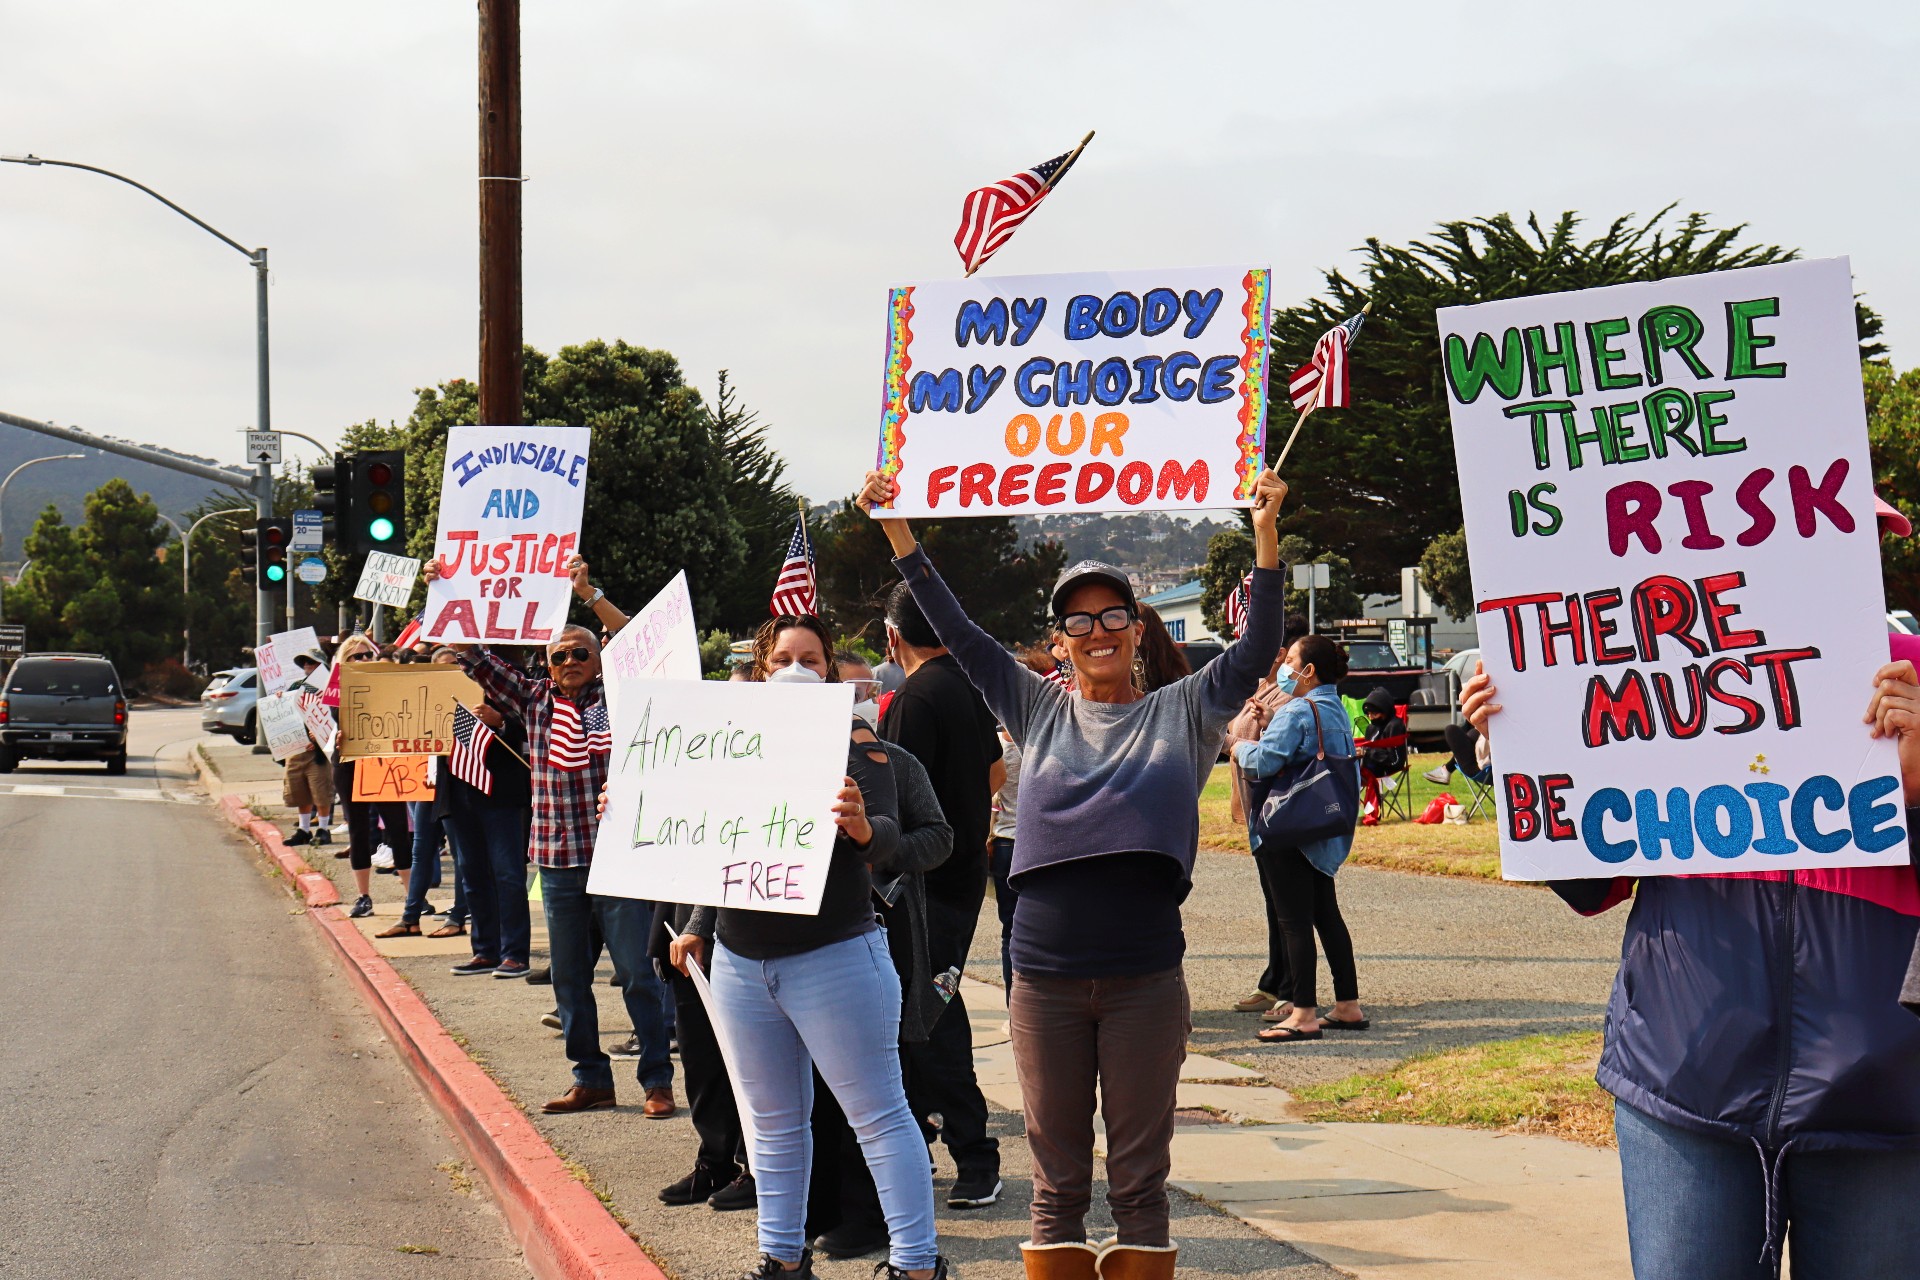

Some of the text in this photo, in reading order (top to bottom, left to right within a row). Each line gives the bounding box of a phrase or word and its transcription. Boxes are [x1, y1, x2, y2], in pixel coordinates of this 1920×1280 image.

[955, 288, 1223, 348] MY BODY
[1444, 297, 1787, 404] WHERE
[909, 351, 1240, 414] MY CHOICE
[250, 434, 278, 442] TRUCK
[1005, 411, 1129, 458] OUR
[1503, 387, 1747, 470] THERE
[482, 488, 540, 520] AND
[927, 459, 1210, 509] FREEDOM
[1508, 458, 1856, 557] IS RISK
[297, 526, 307, 535] 20
[368, 552, 418, 578] COERCION
[439, 531, 577, 580] JUSTICE
[357, 579, 410, 605] CONSENT
[384, 573, 406, 587] NOT
[480, 576, 522, 599] FOR
[427, 600, 553, 640] ALL
[1476, 571, 1767, 672] THERE
[348, 685, 412, 740] Front
[417, 686, 455, 740] Lin
[1581, 645, 1822, 748] MUST
[269, 731, 292, 748] END
[365, 741, 380, 753] to
[621, 697, 764, 775] America
[360, 764, 418, 798] LAB
[632, 789, 814, 855] Land of the
[1503, 772, 1906, 864] BE CHOICE
[722, 861, 805, 905] FREE
